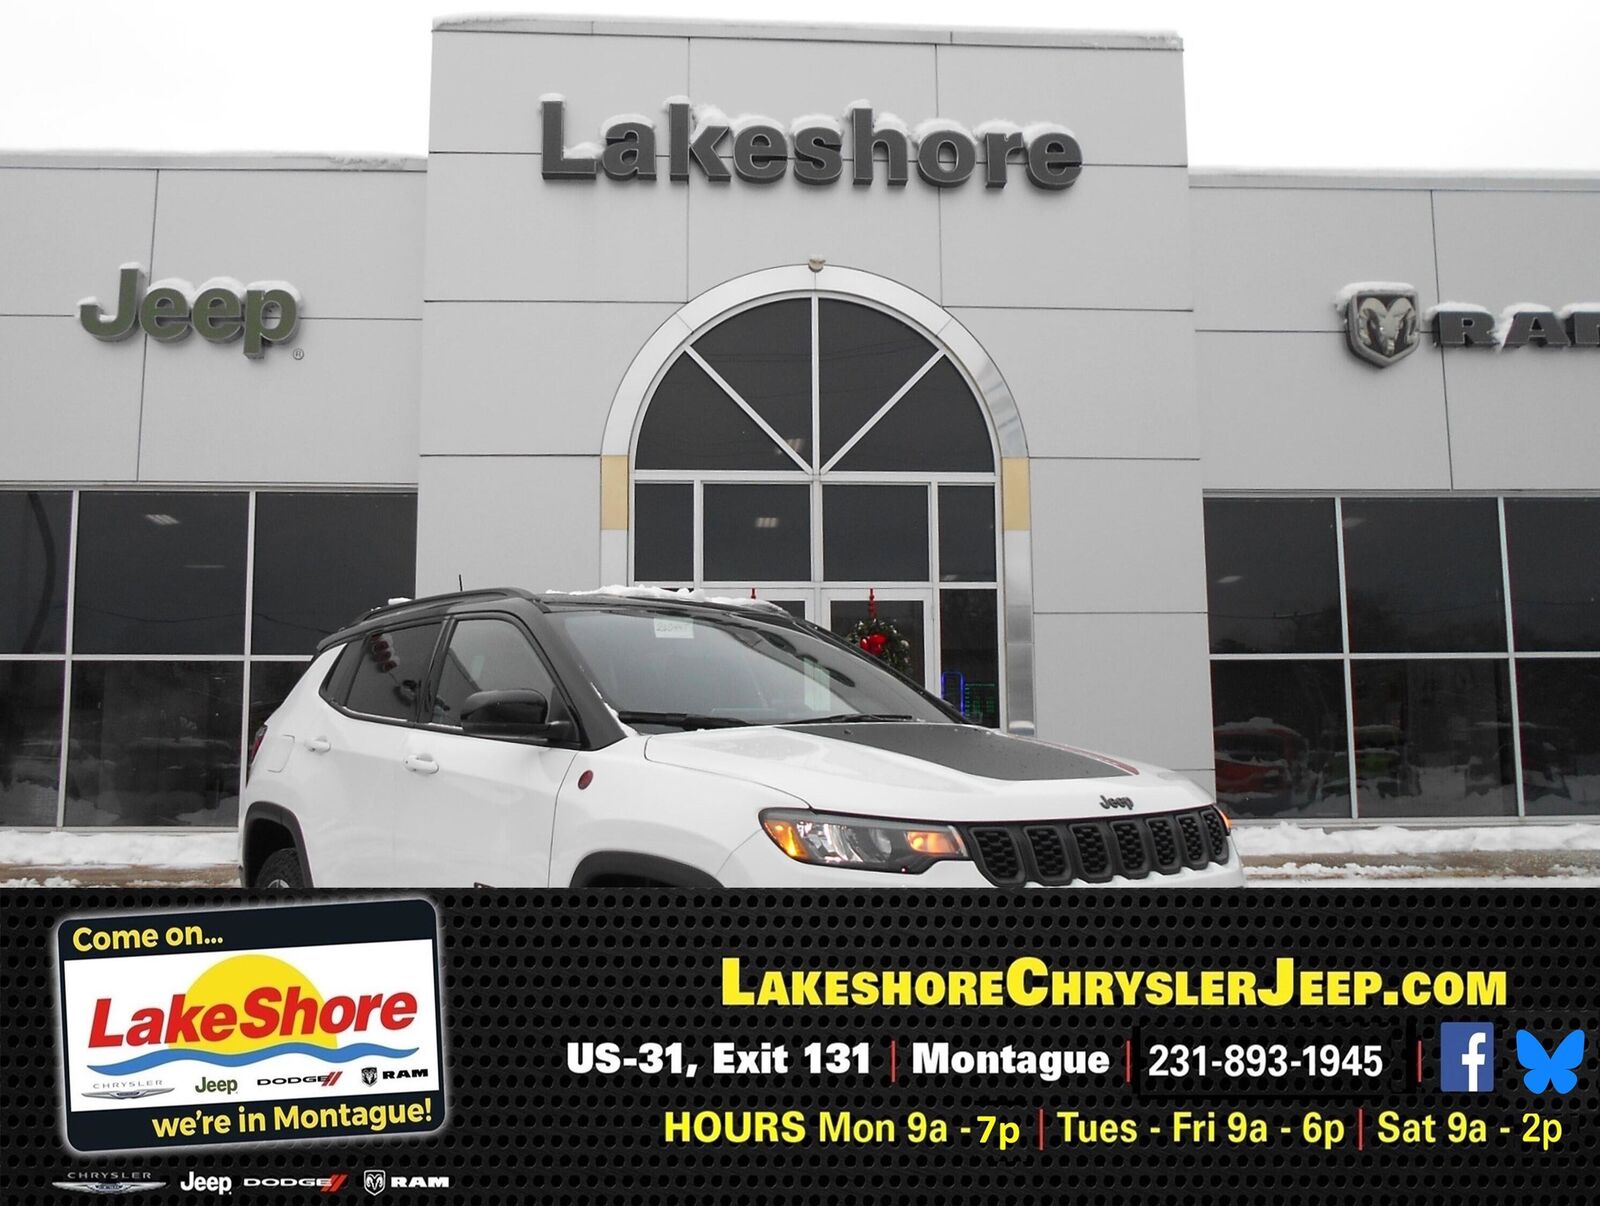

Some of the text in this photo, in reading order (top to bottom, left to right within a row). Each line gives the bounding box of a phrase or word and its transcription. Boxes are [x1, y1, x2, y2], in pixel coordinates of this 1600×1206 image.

[541, 98, 1083, 192] Lakeshore
[78, 266, 299, 359] Jeep
[1100, 795, 1134, 810] Jeep
